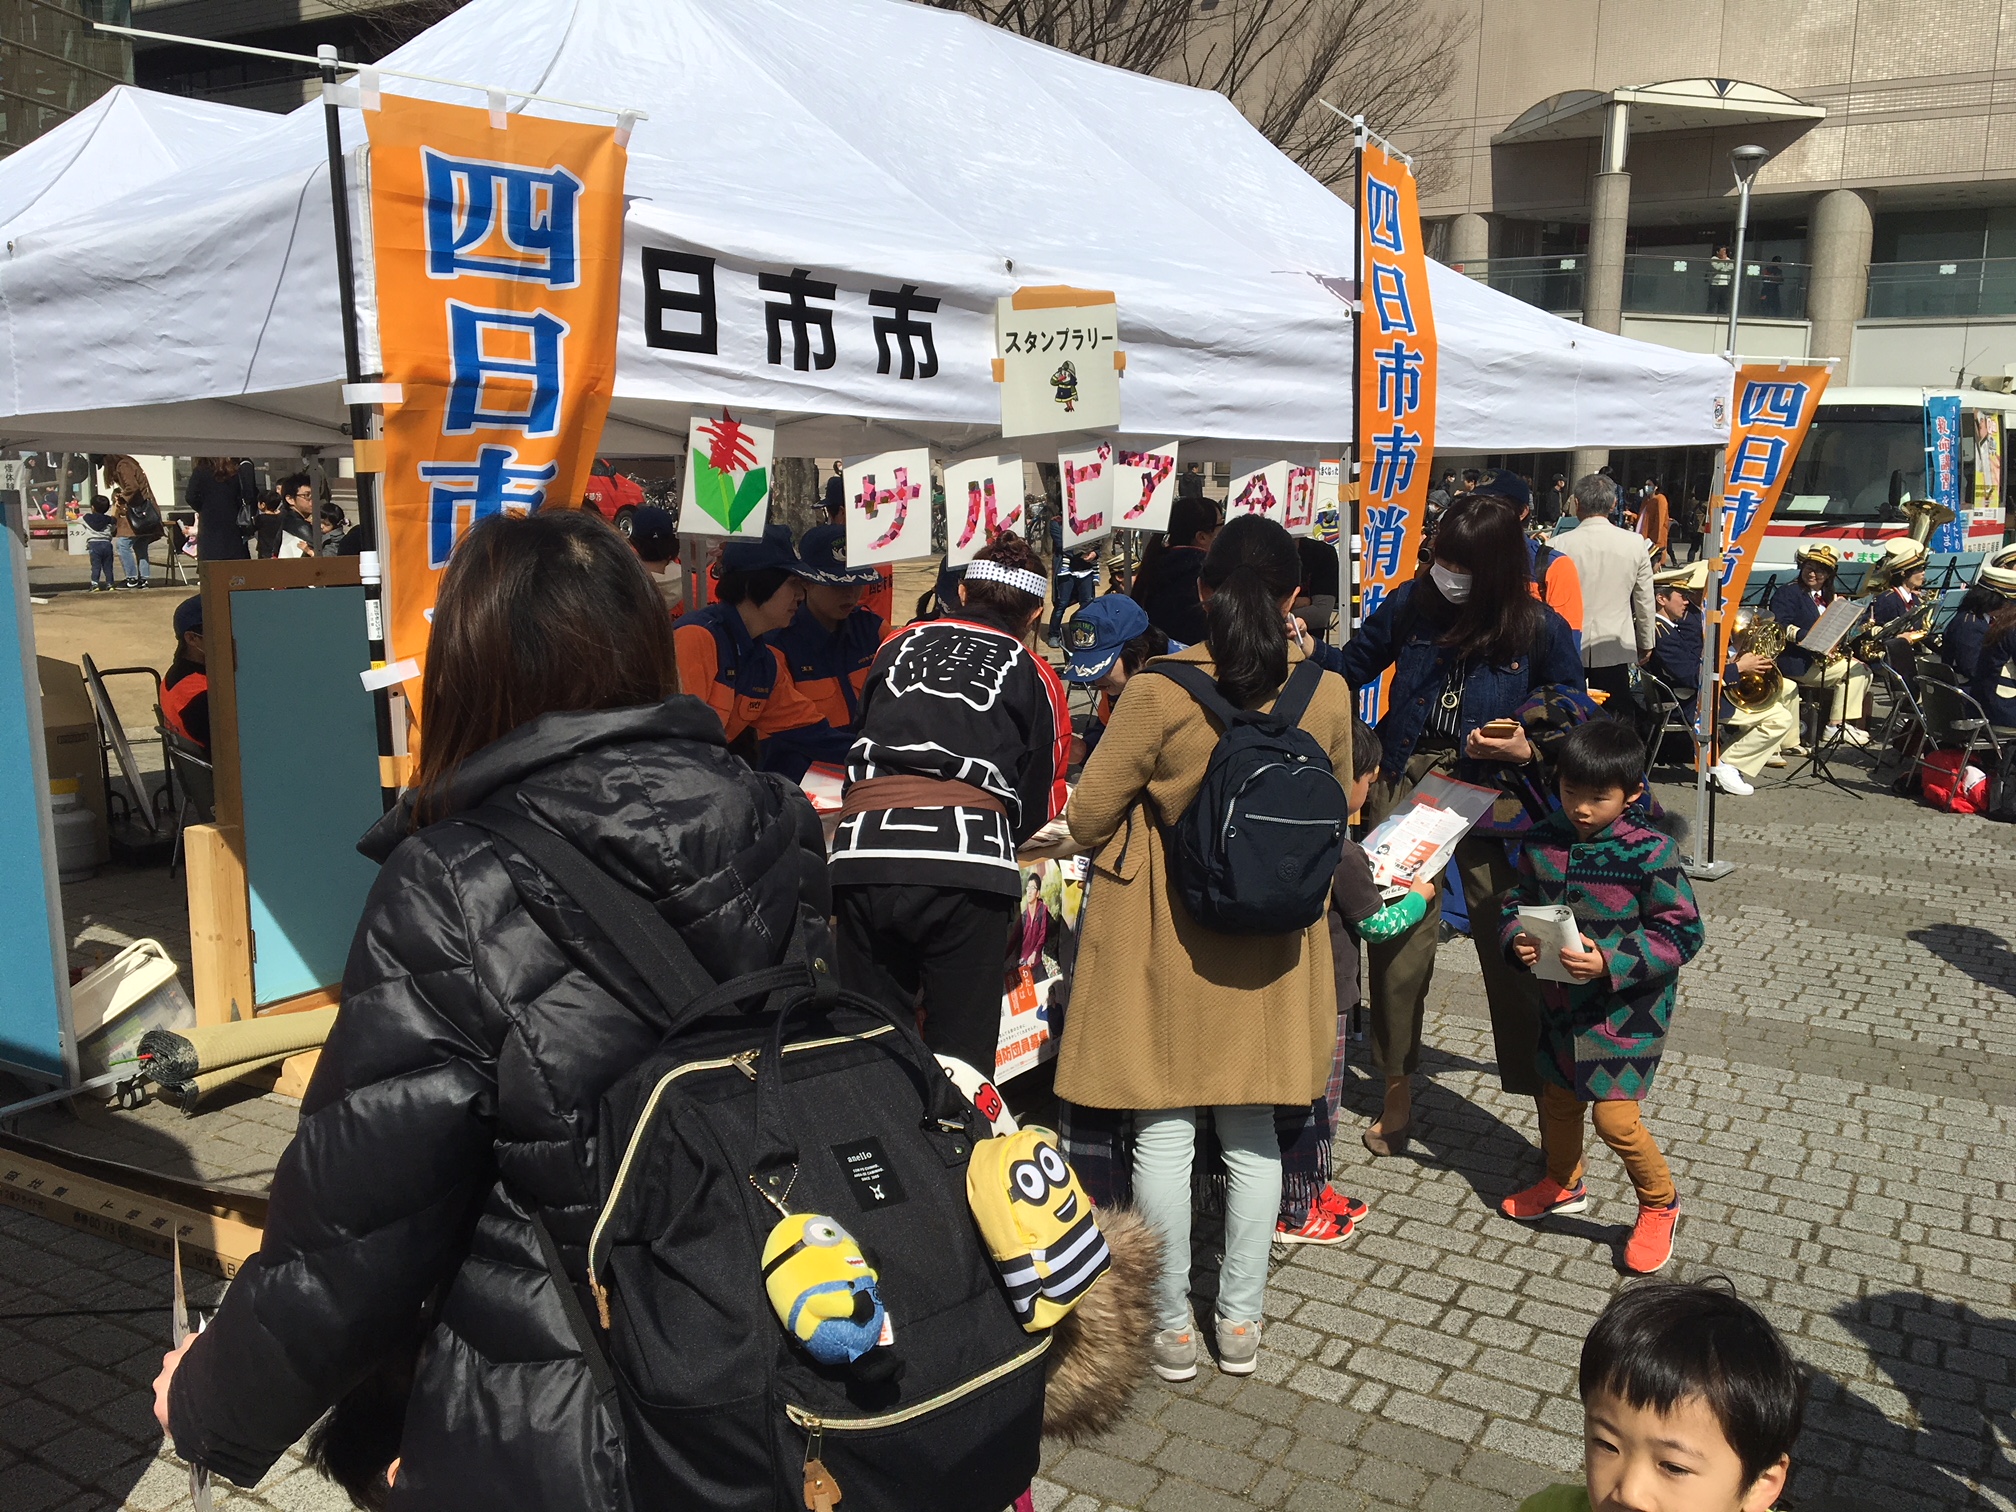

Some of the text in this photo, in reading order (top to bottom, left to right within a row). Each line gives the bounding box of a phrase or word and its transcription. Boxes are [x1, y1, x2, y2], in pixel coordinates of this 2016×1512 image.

[641, 246, 942, 380] 日市市
[1004, 328, 1114, 354] スタンプラリー
[1022, 969, 1033, 997] わたし
[847, 1151, 873, 1163] anello
